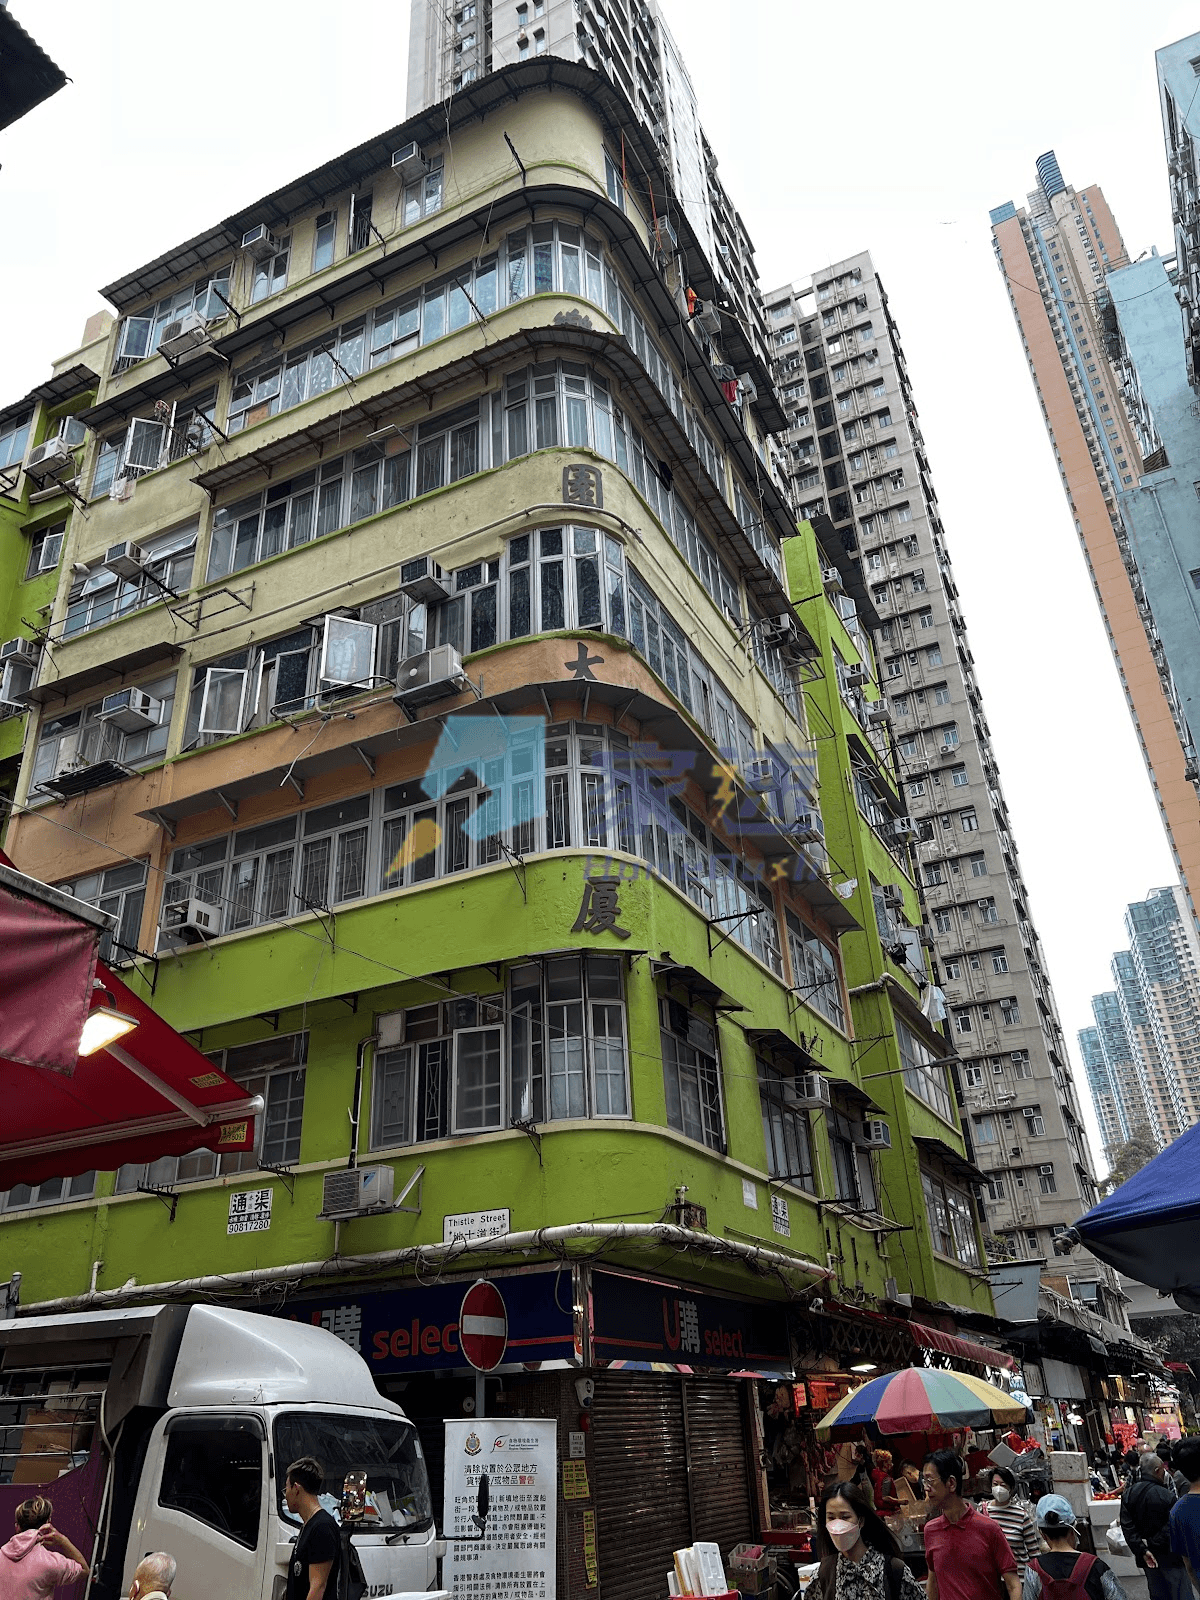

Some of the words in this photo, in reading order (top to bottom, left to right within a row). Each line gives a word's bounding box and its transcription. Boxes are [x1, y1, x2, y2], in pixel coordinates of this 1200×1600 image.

[564, 641, 605, 680] 大
[228, 1220, 269, 1233] 90817280
[448, 1218, 475, 1227] Thistle
[480, 1213, 506, 1223] Street
[371, 1318, 460, 1360] selec
[704, 1324, 745, 1358] select
[464, 1464, 538, 1474] 清除放置於公眾地方
[363, 1584, 394, 1597] SUZU
